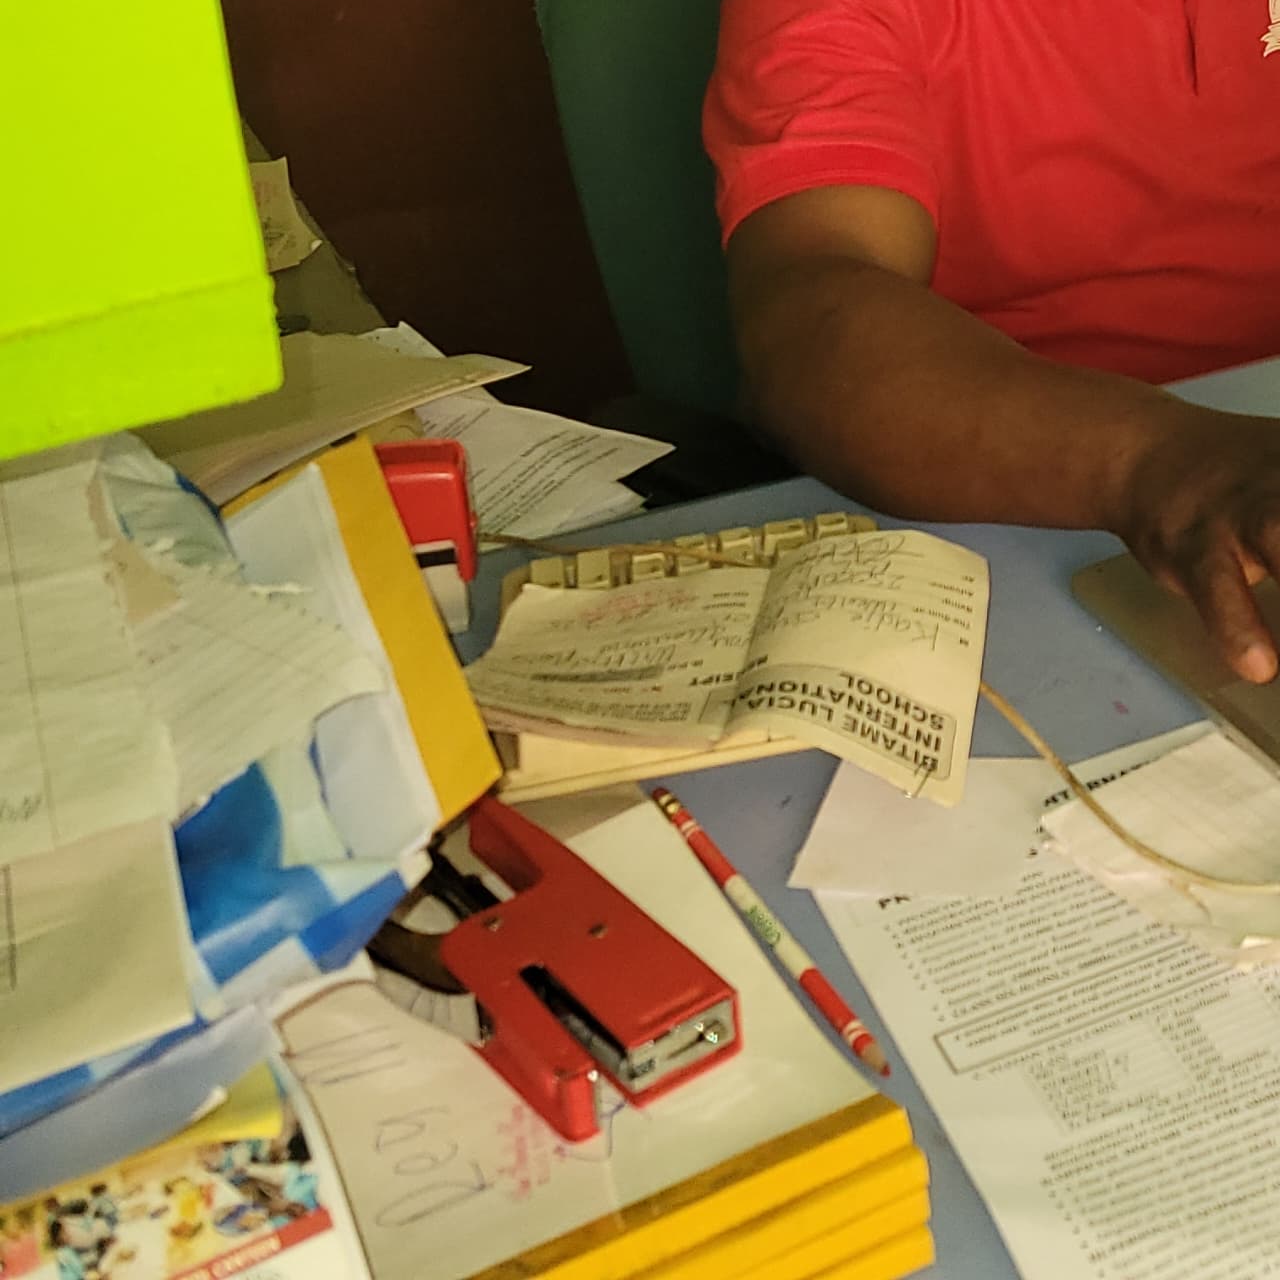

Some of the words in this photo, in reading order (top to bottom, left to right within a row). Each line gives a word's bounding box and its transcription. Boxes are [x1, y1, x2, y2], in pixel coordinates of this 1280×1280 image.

[722, 680, 942, 753] INTERNATIONAL
[746, 699, 835, 724] LUCIA
[838, 673, 945, 732] SCHOOL
[840, 717, 940, 775] BITAME
